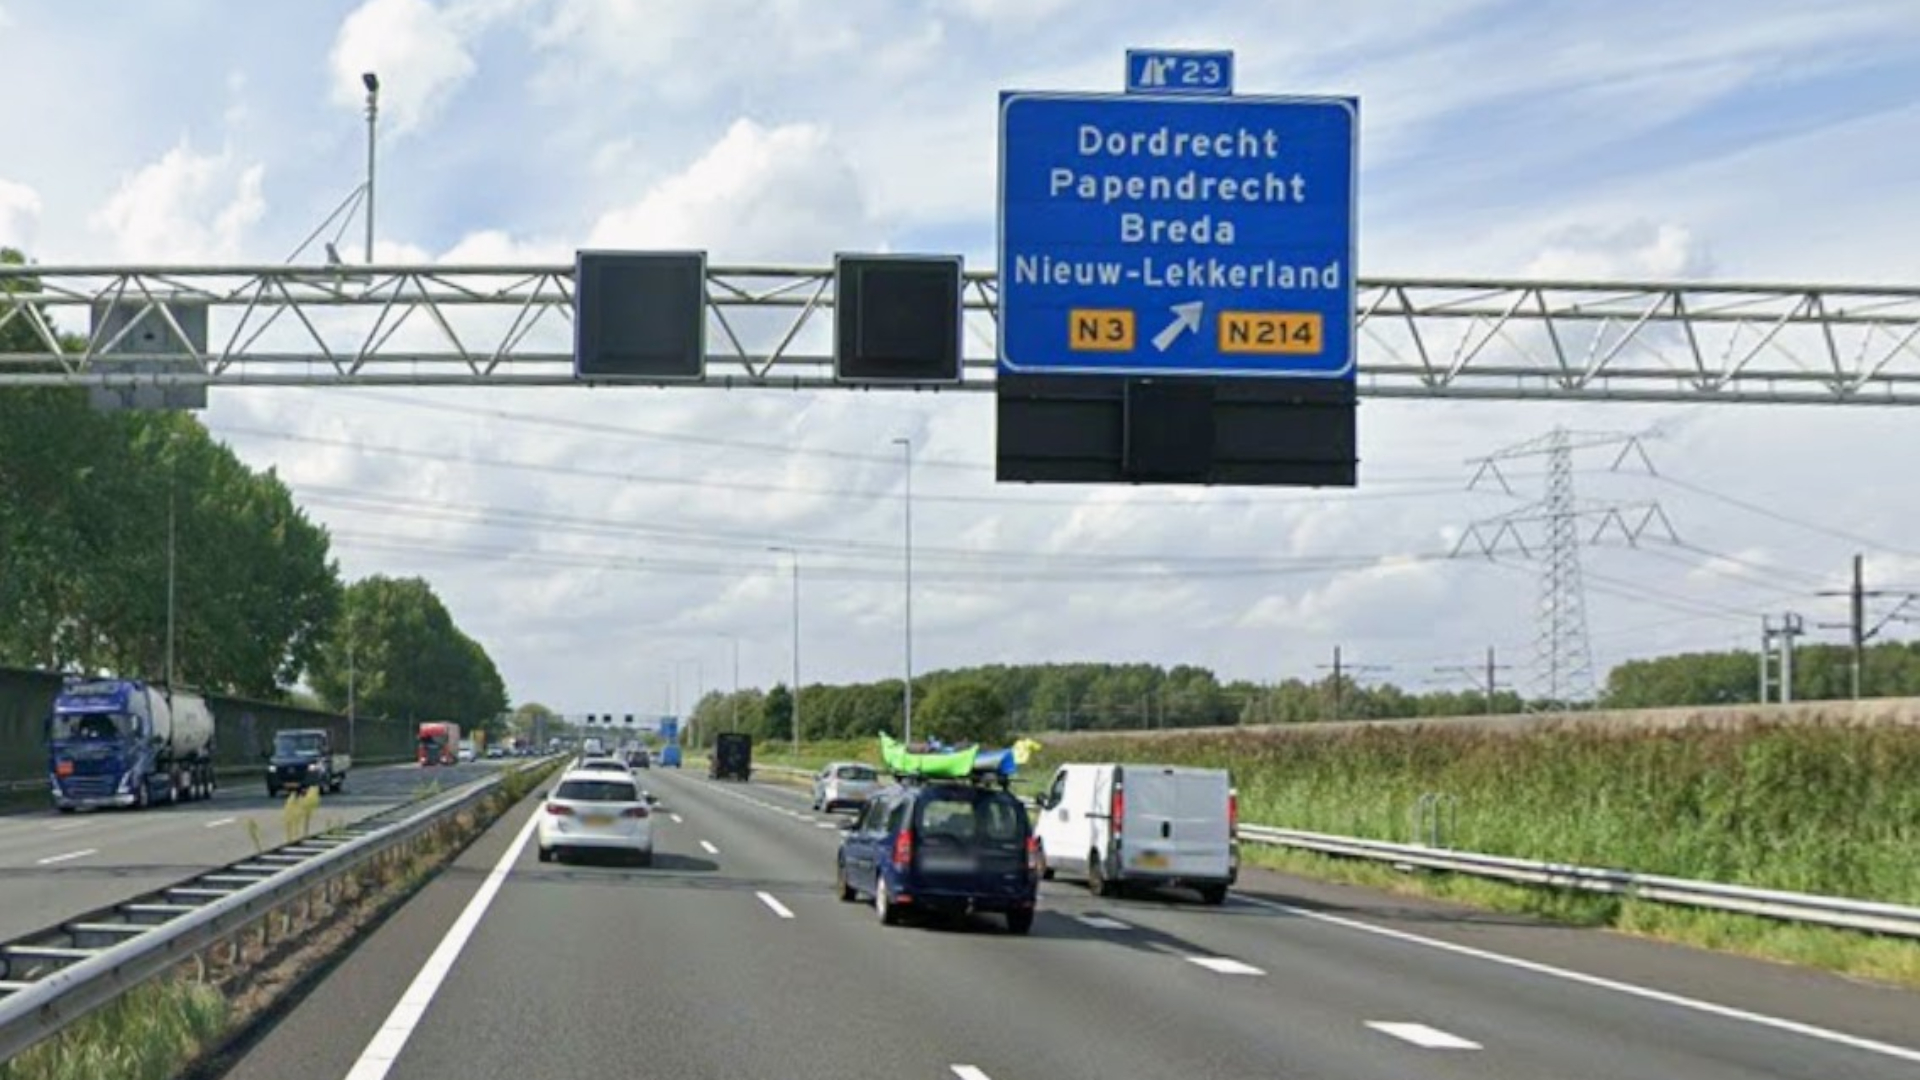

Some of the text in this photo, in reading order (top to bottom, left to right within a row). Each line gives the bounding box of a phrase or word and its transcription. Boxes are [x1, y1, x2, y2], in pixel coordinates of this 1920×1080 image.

[1181, 61, 1221, 83] 23
[1078, 125, 1279, 158] Dordrecht
[1049, 168, 1306, 204] Papendrecht
[1120, 213, 1236, 244] Breda
[1014, 255, 1341, 290] Nieuw-Lekkerland
